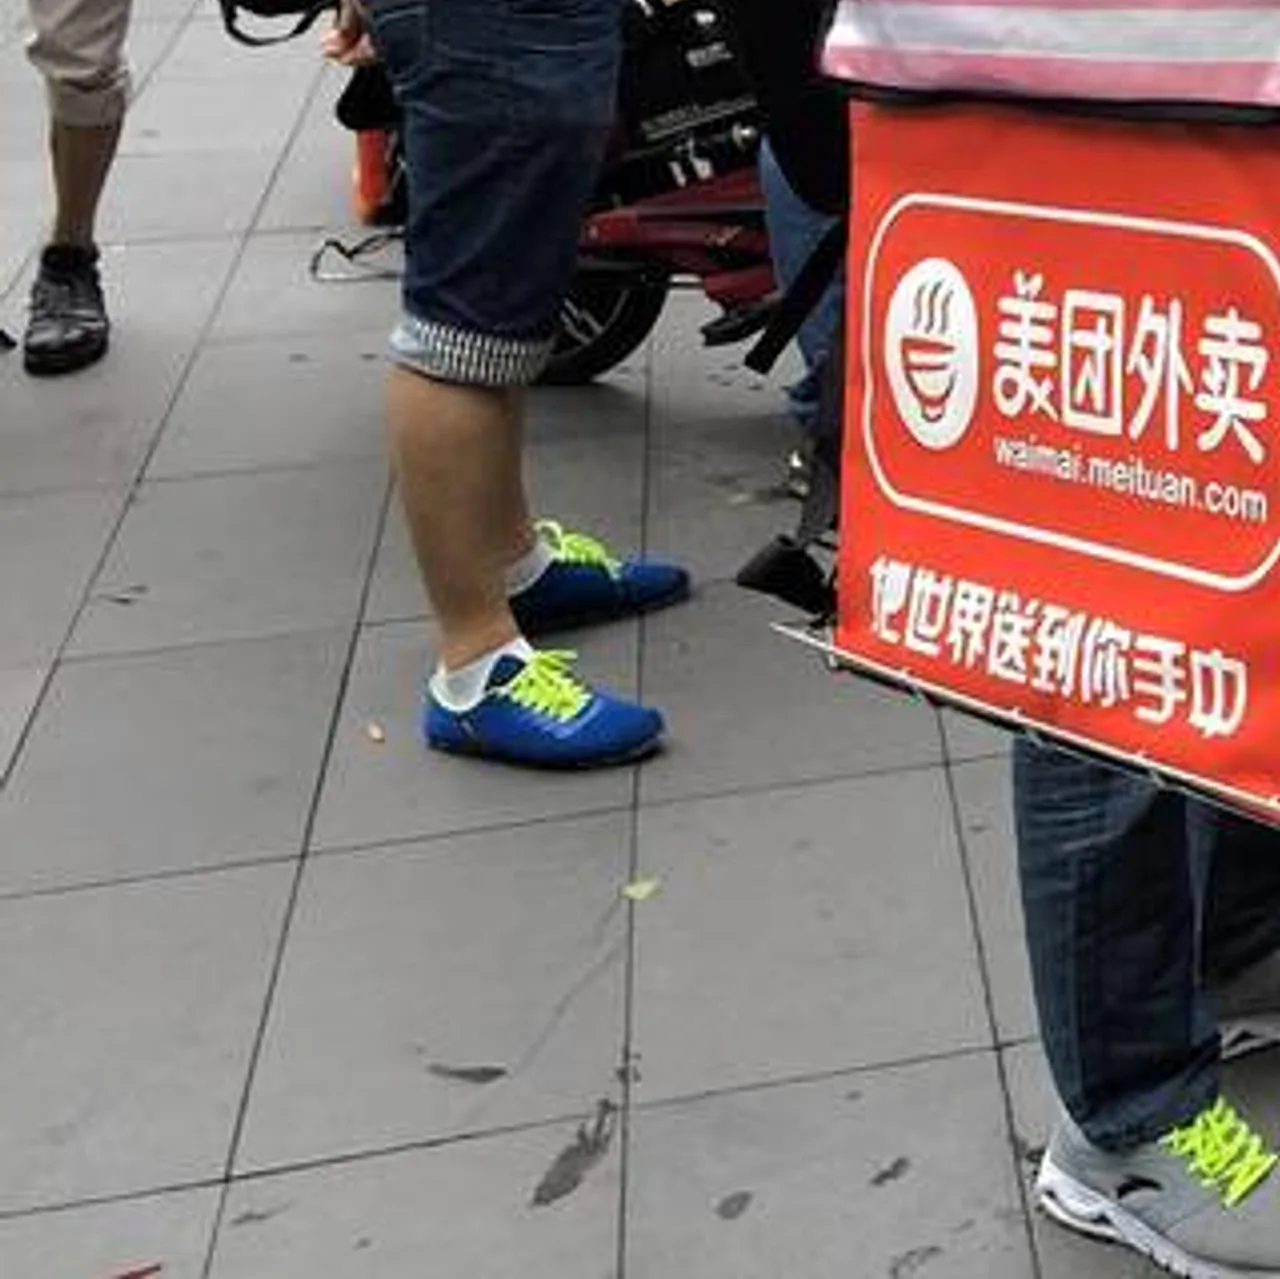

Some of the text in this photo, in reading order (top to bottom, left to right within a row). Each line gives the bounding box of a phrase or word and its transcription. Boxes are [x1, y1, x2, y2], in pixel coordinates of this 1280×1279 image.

[993, 269, 1269, 466] 美团外卖
[993, 433, 1269, 524] waimai.meituan.com
[869, 554, 1249, 739] 把世界送到你手中
